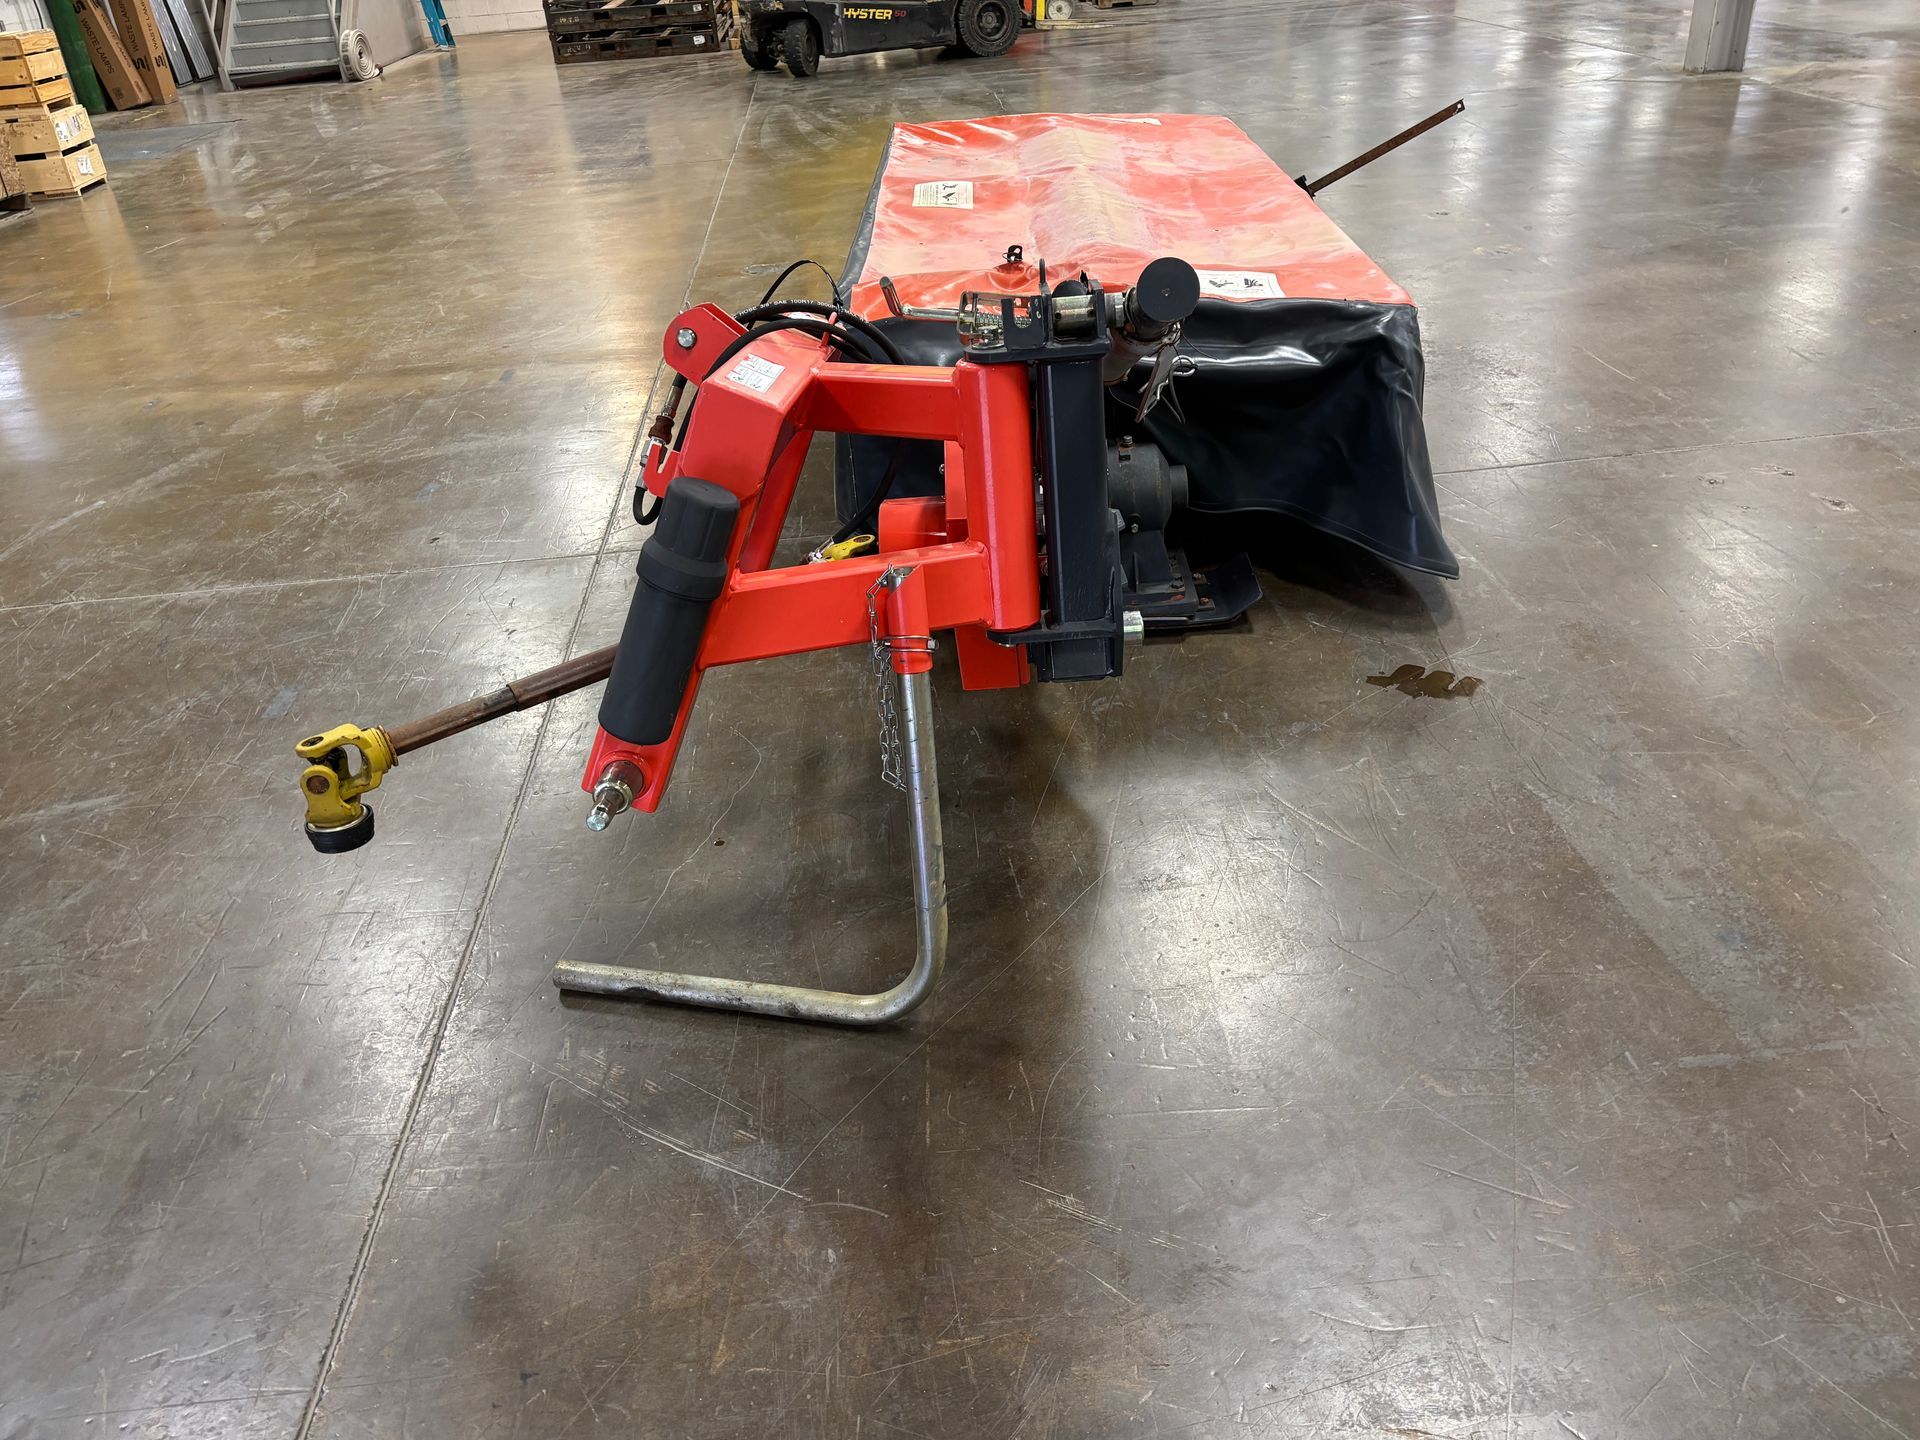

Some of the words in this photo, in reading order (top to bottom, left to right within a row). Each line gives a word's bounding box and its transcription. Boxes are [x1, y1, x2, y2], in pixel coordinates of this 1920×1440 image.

[842, 8, 893, 20] HYSTER
[81, 18, 99, 48] WASTE
[96, 47, 115, 74] LAMPS
[126, 24, 140, 52] WASTE
[147, 22, 158, 50] WASTE
[739, 307, 757, 316] HOSE
